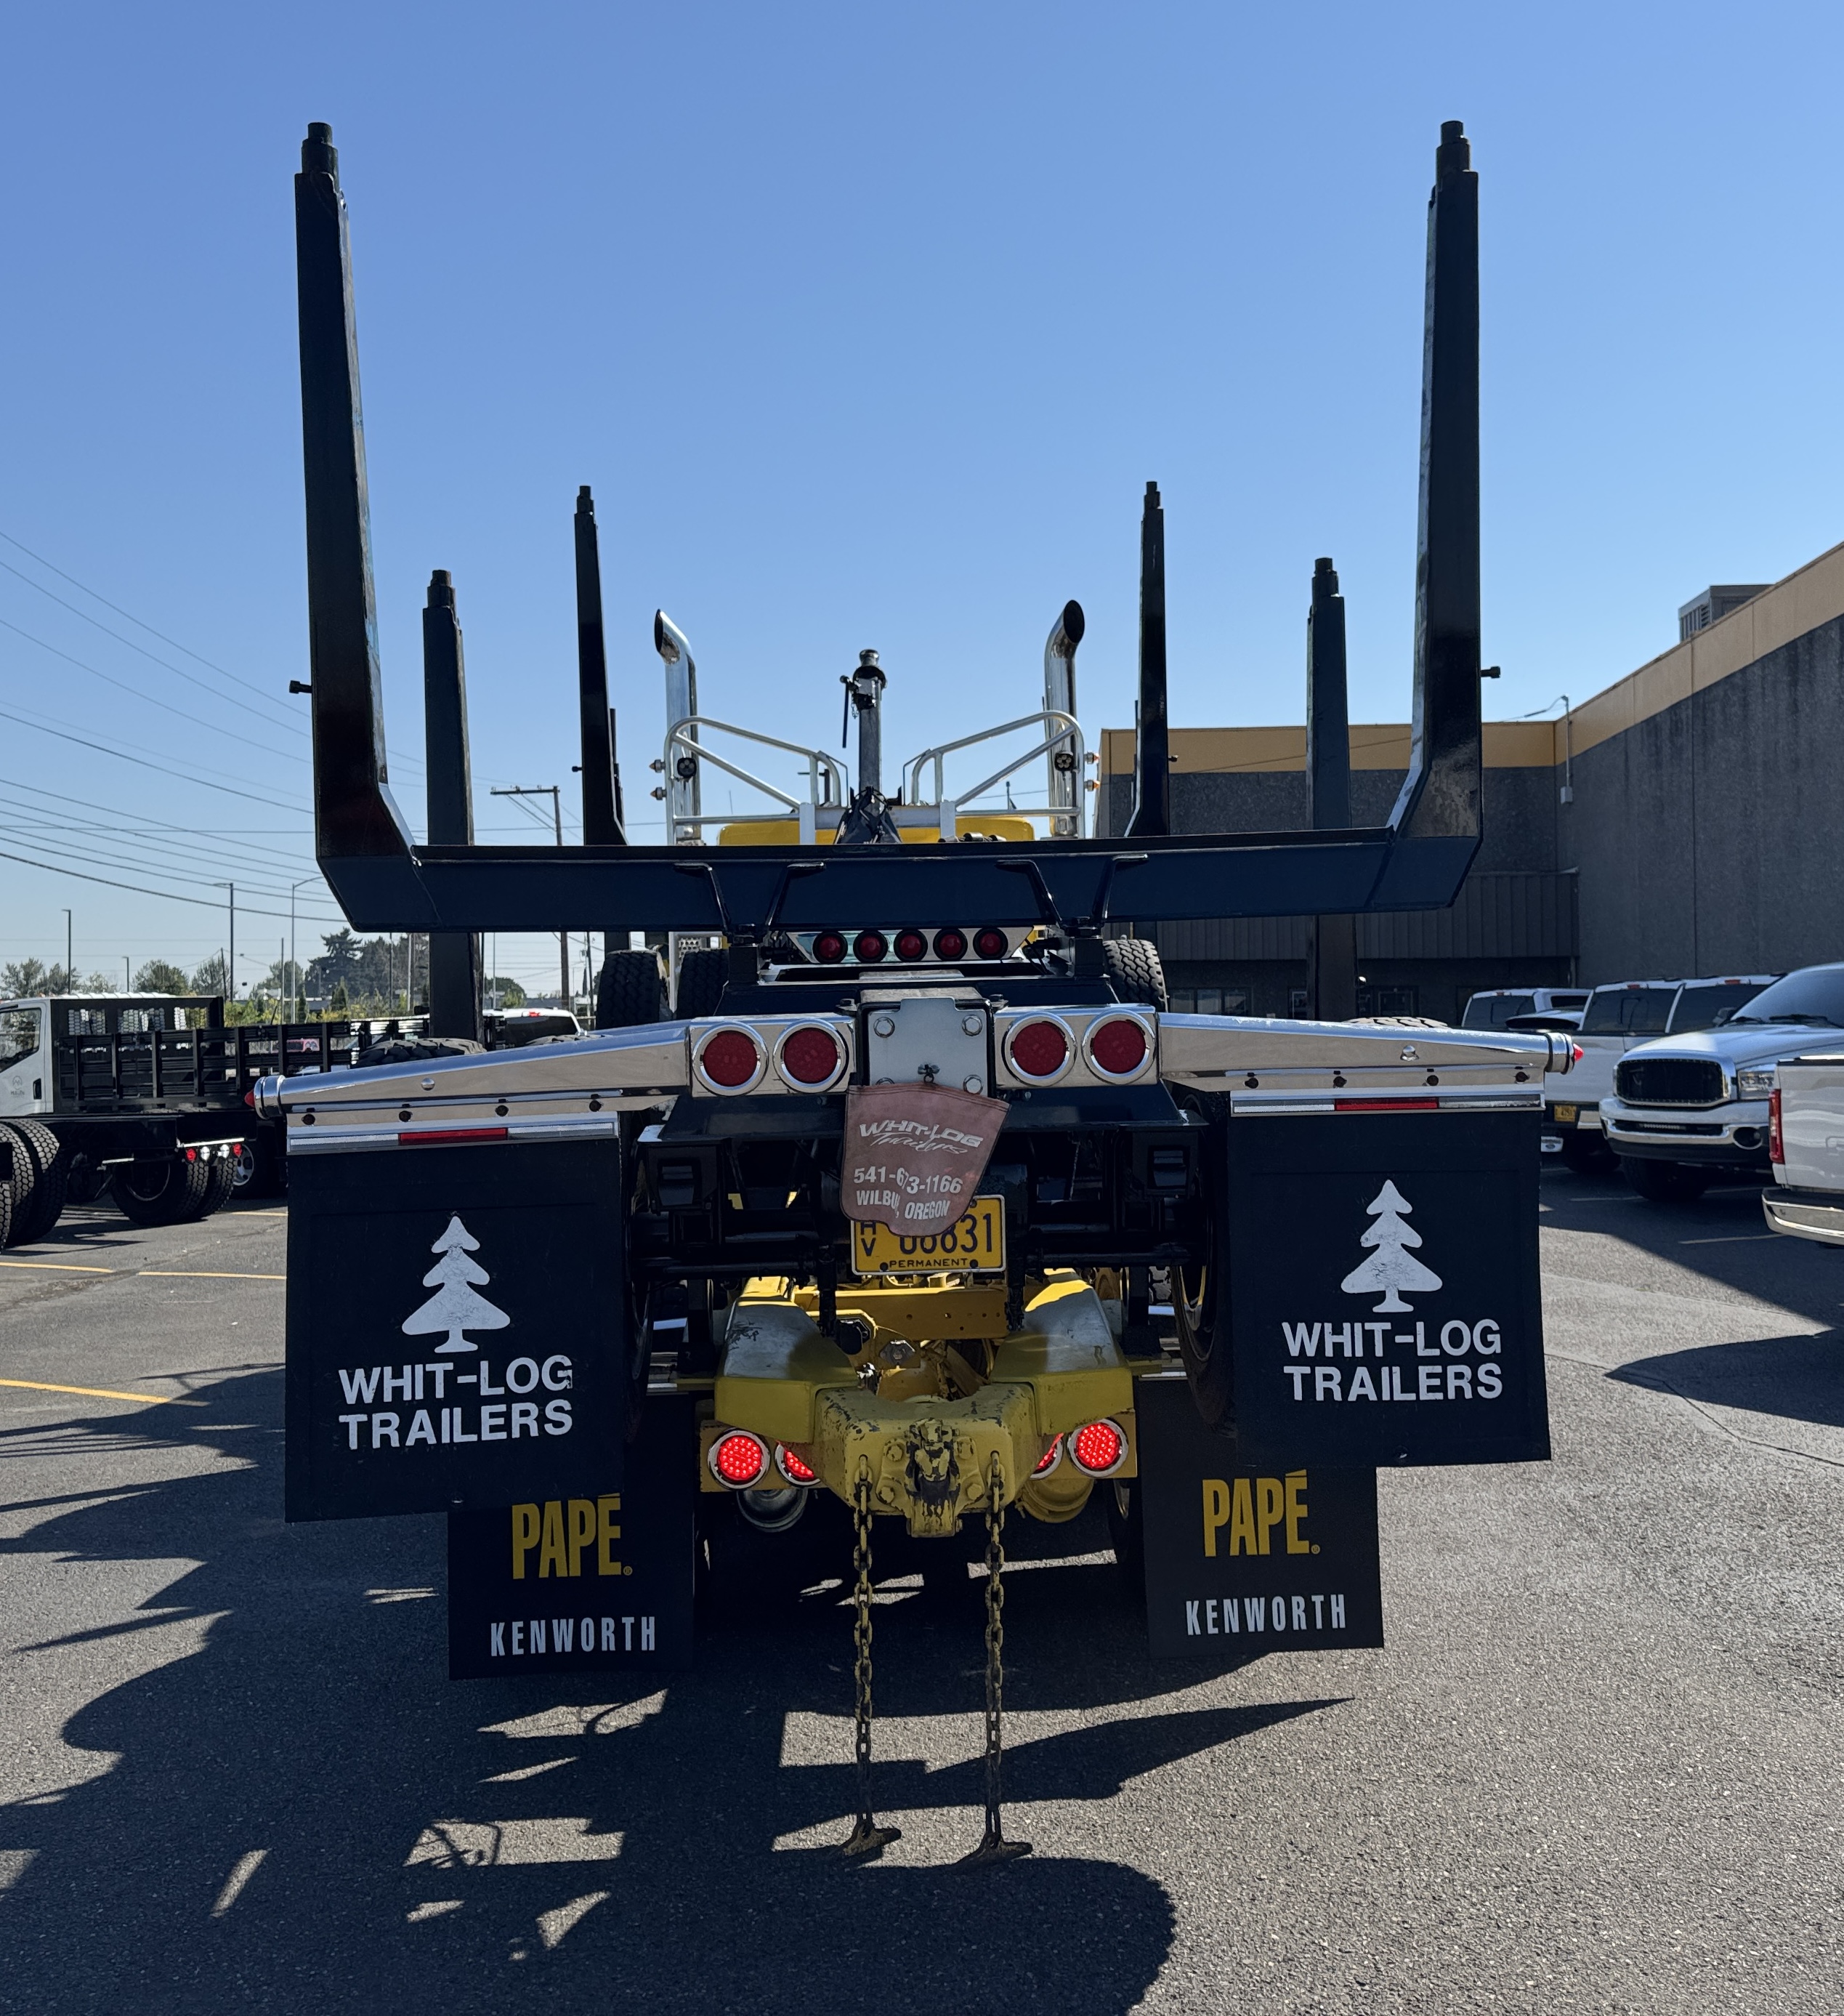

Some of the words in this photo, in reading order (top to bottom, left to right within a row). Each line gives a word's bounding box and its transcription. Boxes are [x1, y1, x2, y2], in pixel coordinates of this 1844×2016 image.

[860, 1119, 983, 1148] WHIT-LOG
[854, 1166, 963, 1194] 541-673-1166
[905, 1200, 950, 1219] OREGON
[889, 1258, 968, 1268] PERMANENT
[1281, 1318, 1501, 1358] WHIT-LOG
[338, 1355, 573, 1405] WHIT-LOG
[1283, 1363, 1503, 1402] TRAILERS
[338, 1399, 573, 1450] TRAILERS
[1202, 1469, 1310, 1557] PAPÉ
[1186, 1594, 1346, 1636] KENWORTH
[490, 1616, 655, 1657] KENWORTH
